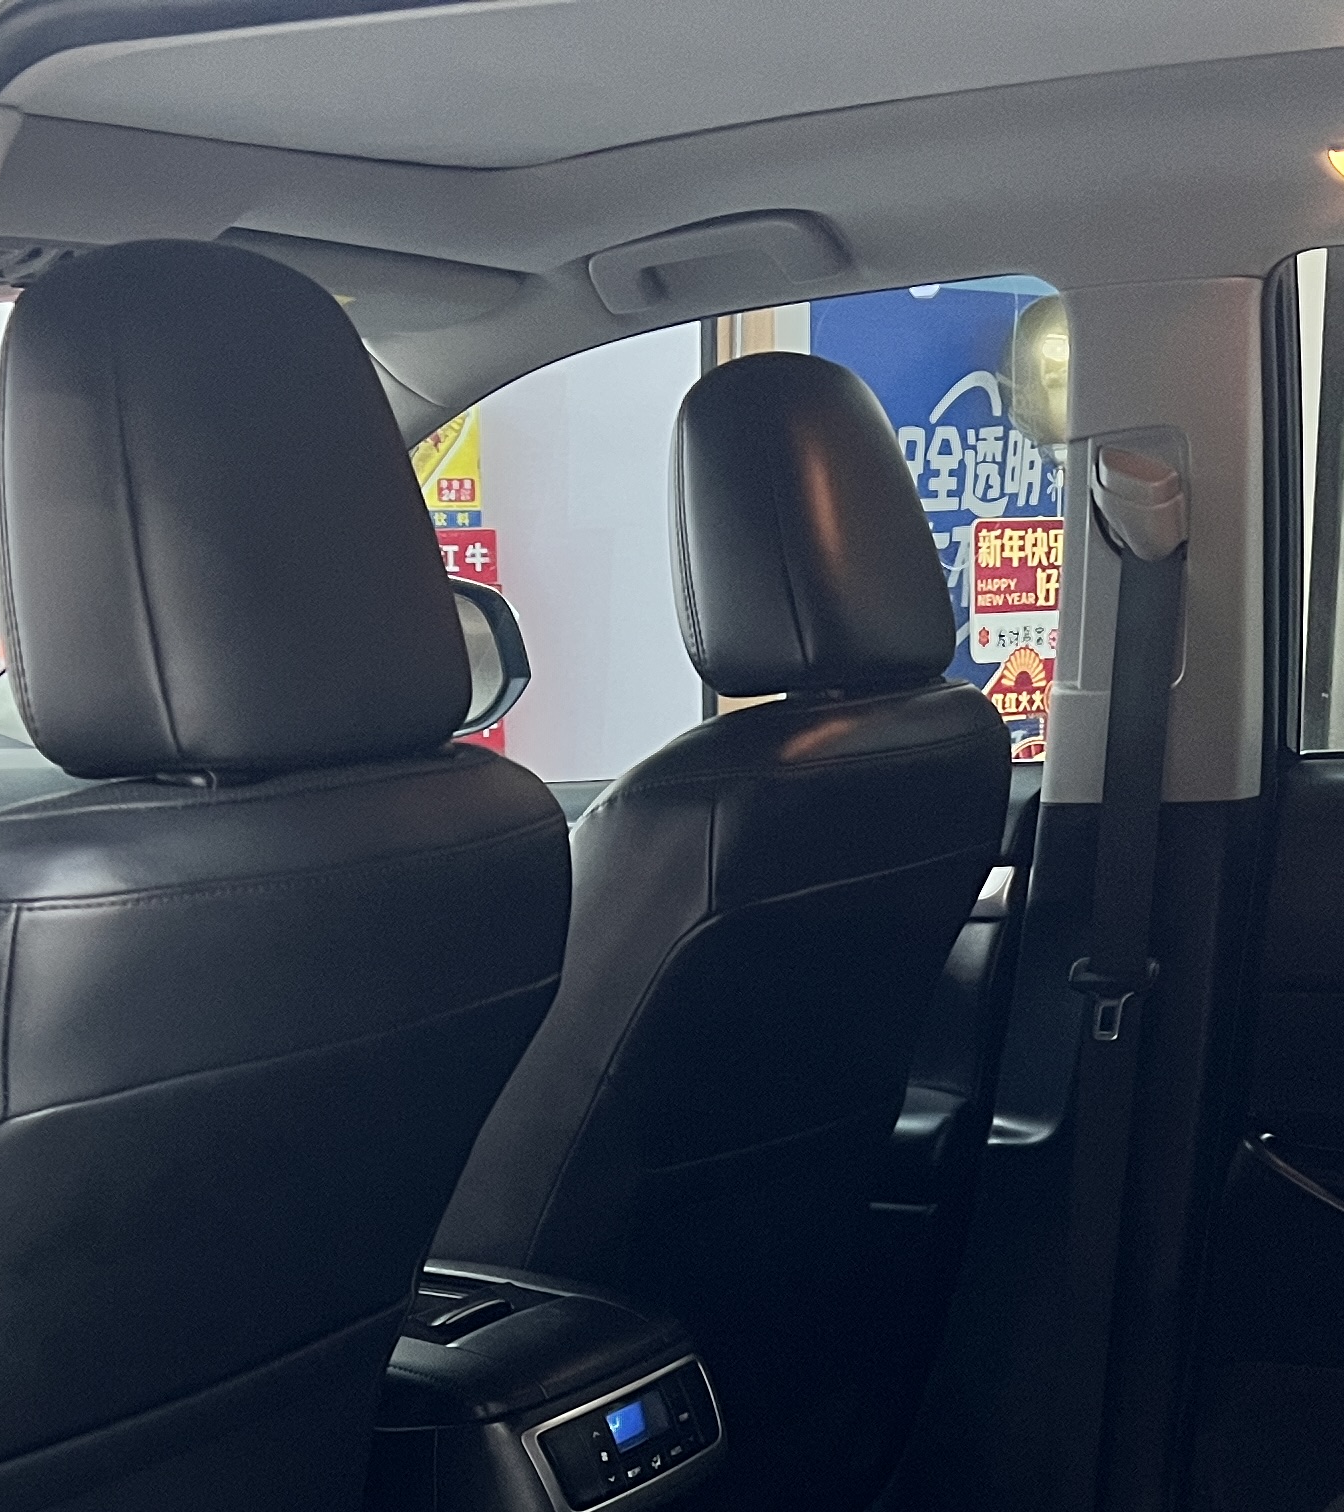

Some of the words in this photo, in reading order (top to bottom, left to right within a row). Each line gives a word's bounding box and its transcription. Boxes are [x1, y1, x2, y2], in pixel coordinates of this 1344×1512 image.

[977, 579, 1017, 591] HAPPY
[977, 594, 1003, 606] NEW
[1006, 593, 1035, 605] YEAR
